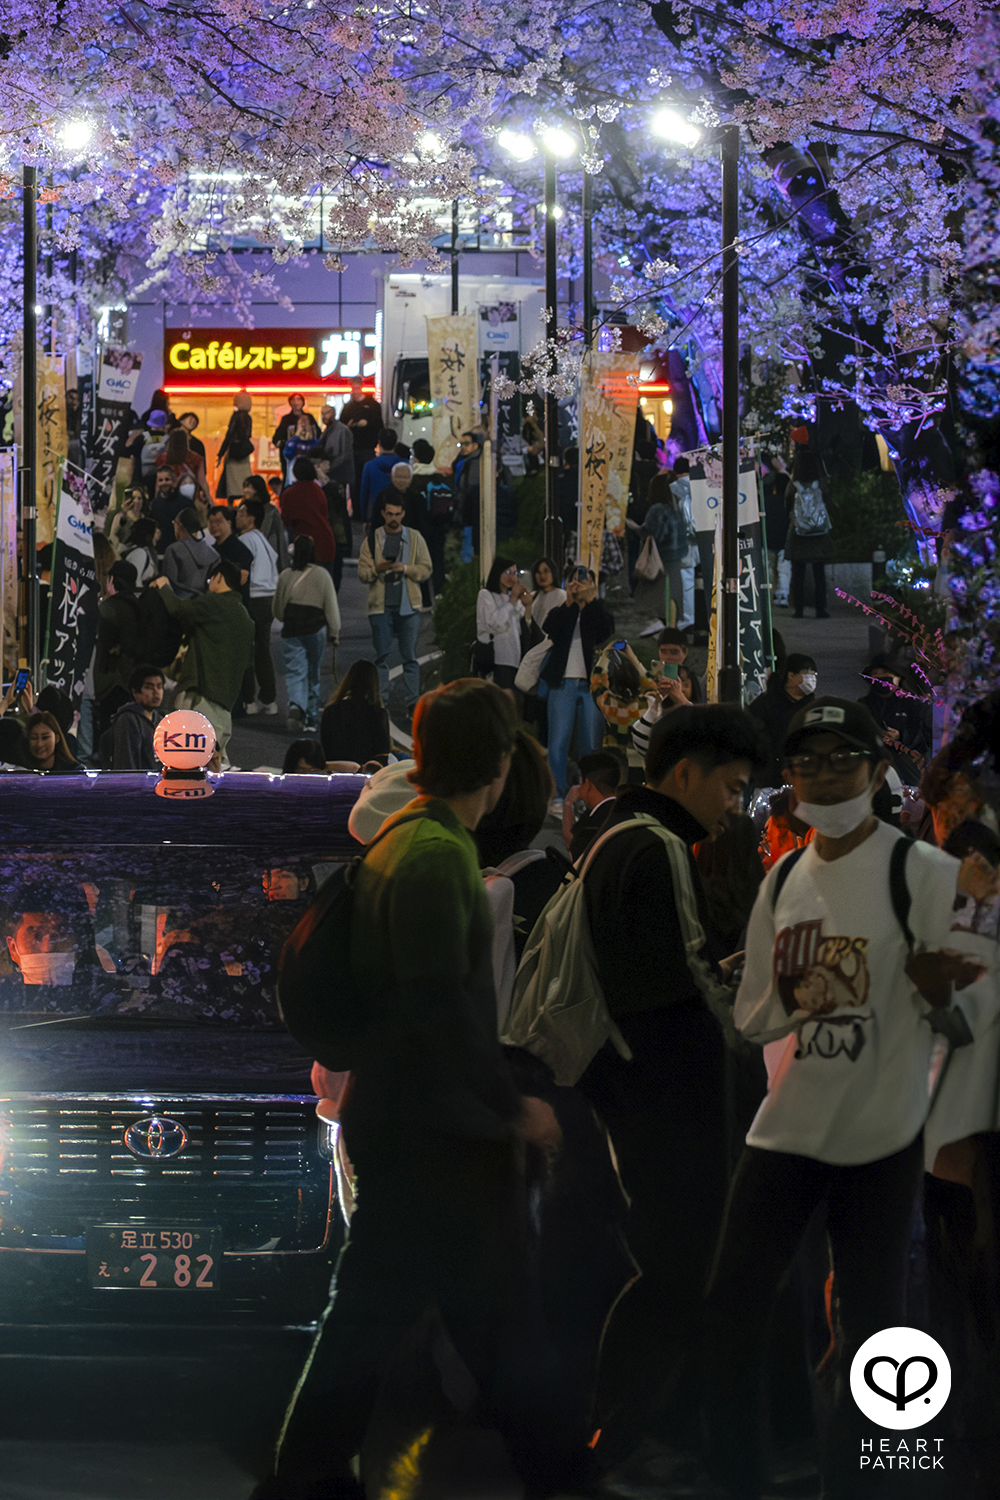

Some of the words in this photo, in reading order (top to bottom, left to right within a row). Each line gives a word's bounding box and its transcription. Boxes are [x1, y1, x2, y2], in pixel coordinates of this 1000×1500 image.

[169, 342, 315, 370] Caféレストラン
[164, 731, 206, 748] km
[121, 1231, 157, 1249] 足立
[160, 1232, 193, 1249] 530
